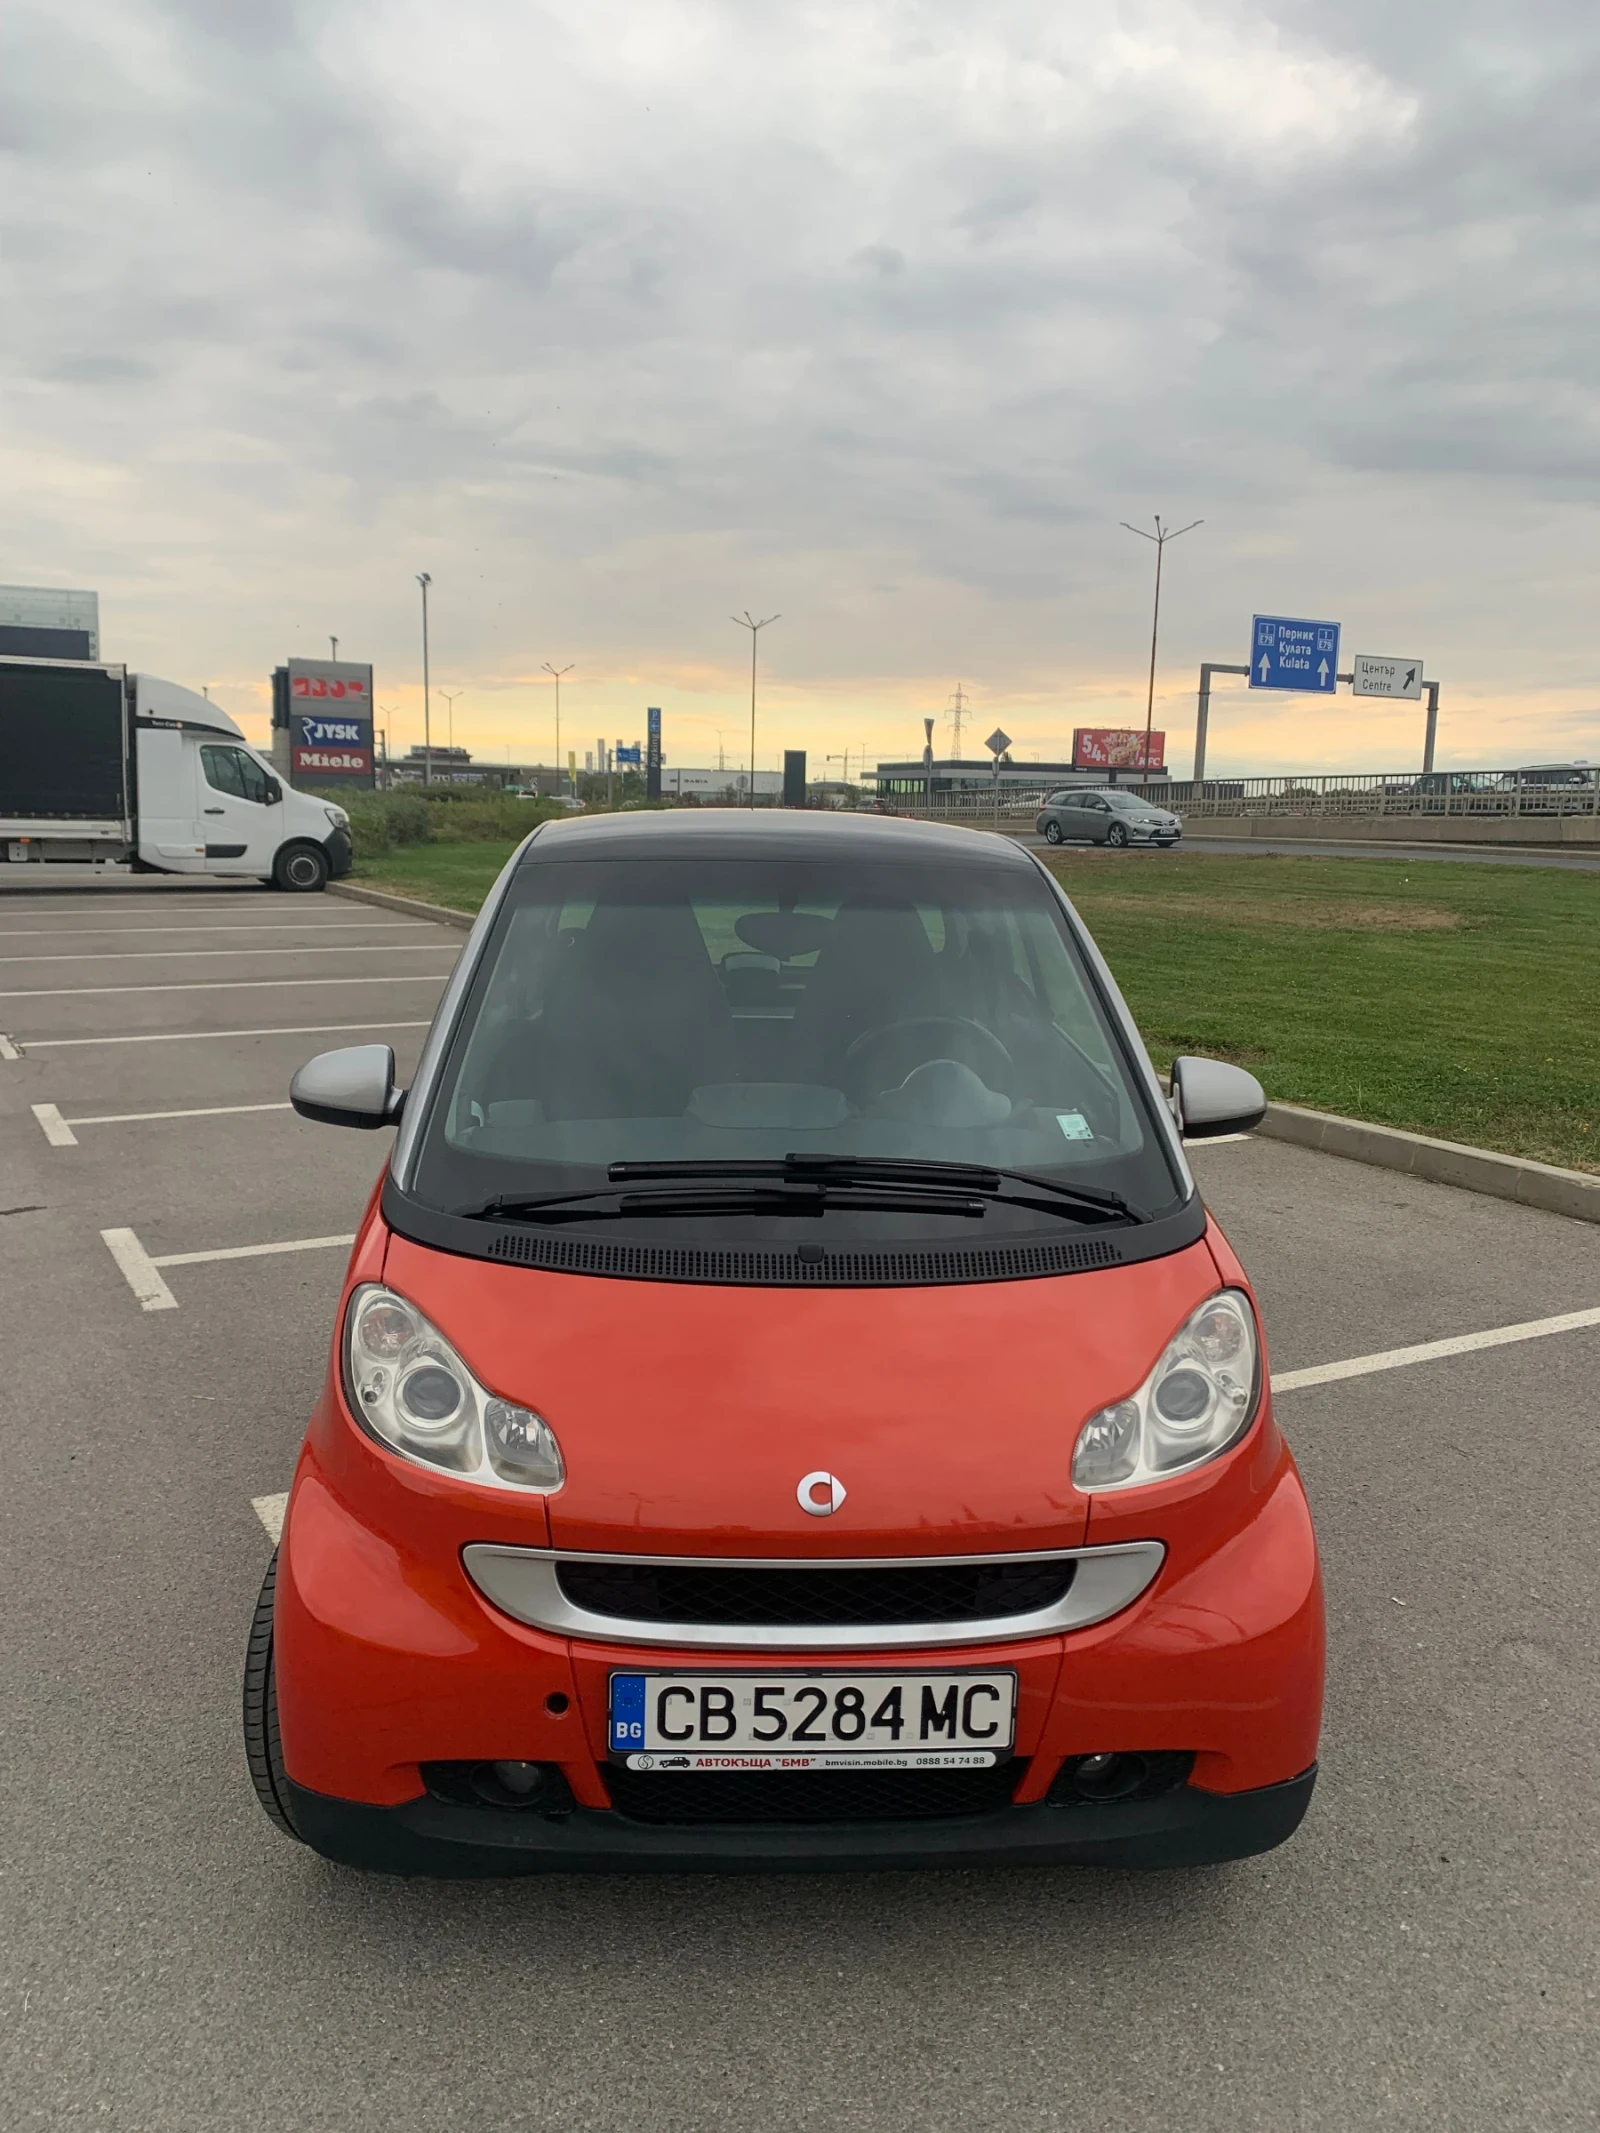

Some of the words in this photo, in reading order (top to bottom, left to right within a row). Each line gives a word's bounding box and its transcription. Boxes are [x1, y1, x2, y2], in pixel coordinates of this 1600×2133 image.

[1259, 635, 1273, 644] E79
[1278, 626, 1314, 641] Перник
[1279, 641, 1312, 656] Кулата
[1318, 640, 1332, 650] E79
[1279, 656, 1310, 670] Kulata
[1361, 661, 1396, 677] Център
[1362, 678, 1392, 691] Centre
[314, 723, 359, 740] JYSK
[650, 733, 660, 768] Parking
[1082, 734, 1093, 753] 5
[299, 752, 364, 768] Miele
[1138, 757, 1160, 766] KFC
[657, 1685, 737, 1741] CB
[753, 1685, 904, 1741] 5284
[920, 1684, 1000, 1740] MC
[616, 1722, 642, 1738] BG
[696, 1758, 772, 1768] АВТОКЪЩА
[825, 1759, 908, 1767] bmvisin.mobile.bg
[958, 1757, 970, 1765] 74
